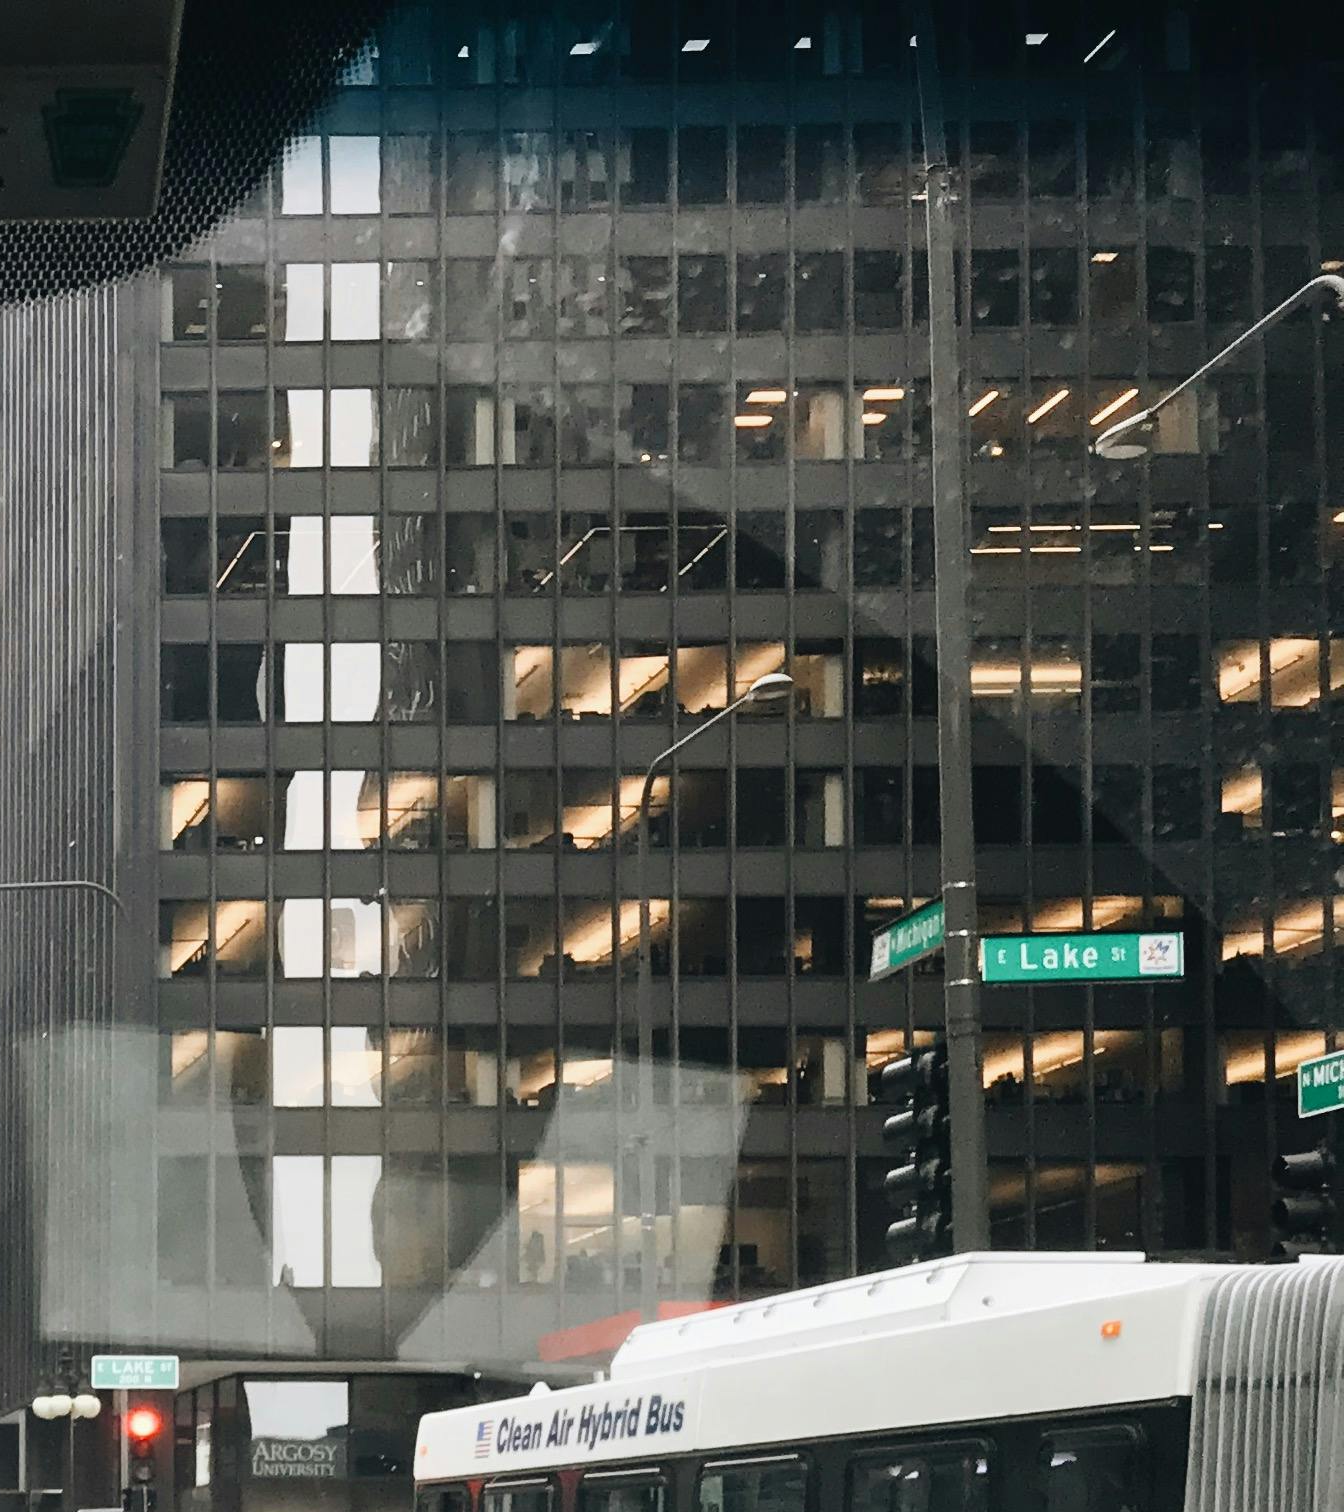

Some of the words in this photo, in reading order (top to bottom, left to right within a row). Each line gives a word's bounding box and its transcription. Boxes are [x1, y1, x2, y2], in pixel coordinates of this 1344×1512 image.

[997, 948, 1007, 965] E
[1020, 942, 1099, 970] Lake
[1111, 946, 1127, 962] St
[1302, 1070, 1311, 1088] N
[111, 1360, 155, 1375] LAKE
[496, 1416, 543, 1454] Clean
[546, 1407, 576, 1448] Air
[577, 1397, 643, 1450] Hybrid
[645, 1395, 686, 1435] Bus
[253, 1440, 339, 1462] ARGOSY
[252, 1460, 337, 1477] UNIVERSITY
